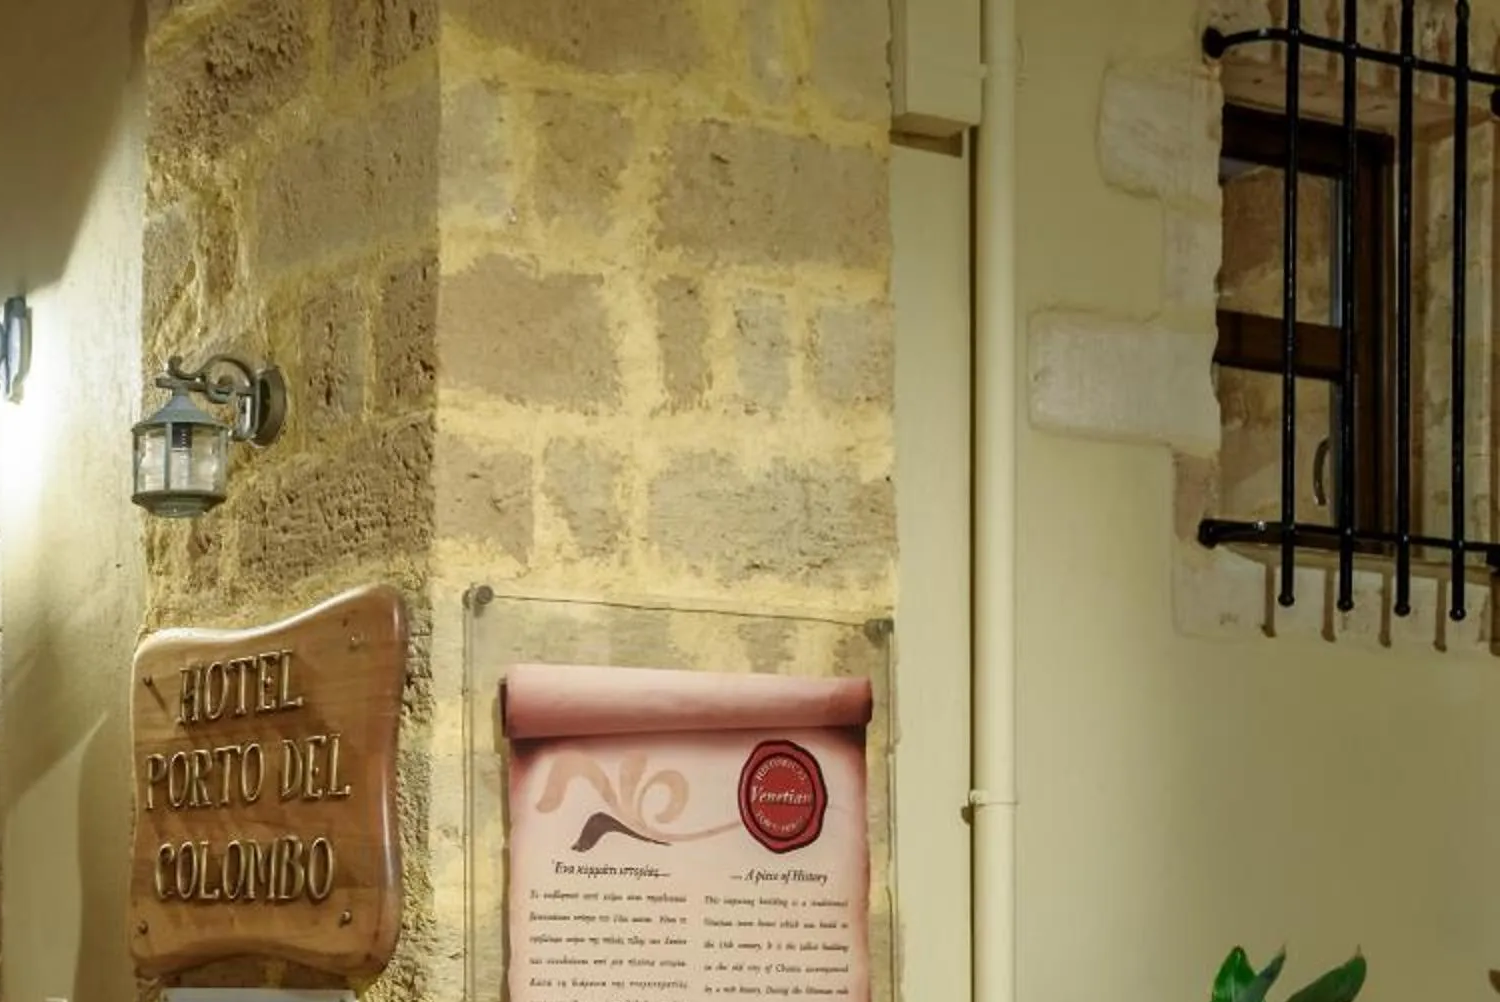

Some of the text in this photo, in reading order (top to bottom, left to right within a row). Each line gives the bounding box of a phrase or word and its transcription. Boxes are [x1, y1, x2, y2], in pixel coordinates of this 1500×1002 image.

[179, 650, 304, 725] HOTEL
[145, 733, 350, 811] PORTO DEL
[155, 835, 335, 901] COLOMBO
[791, 869, 828, 887] History
